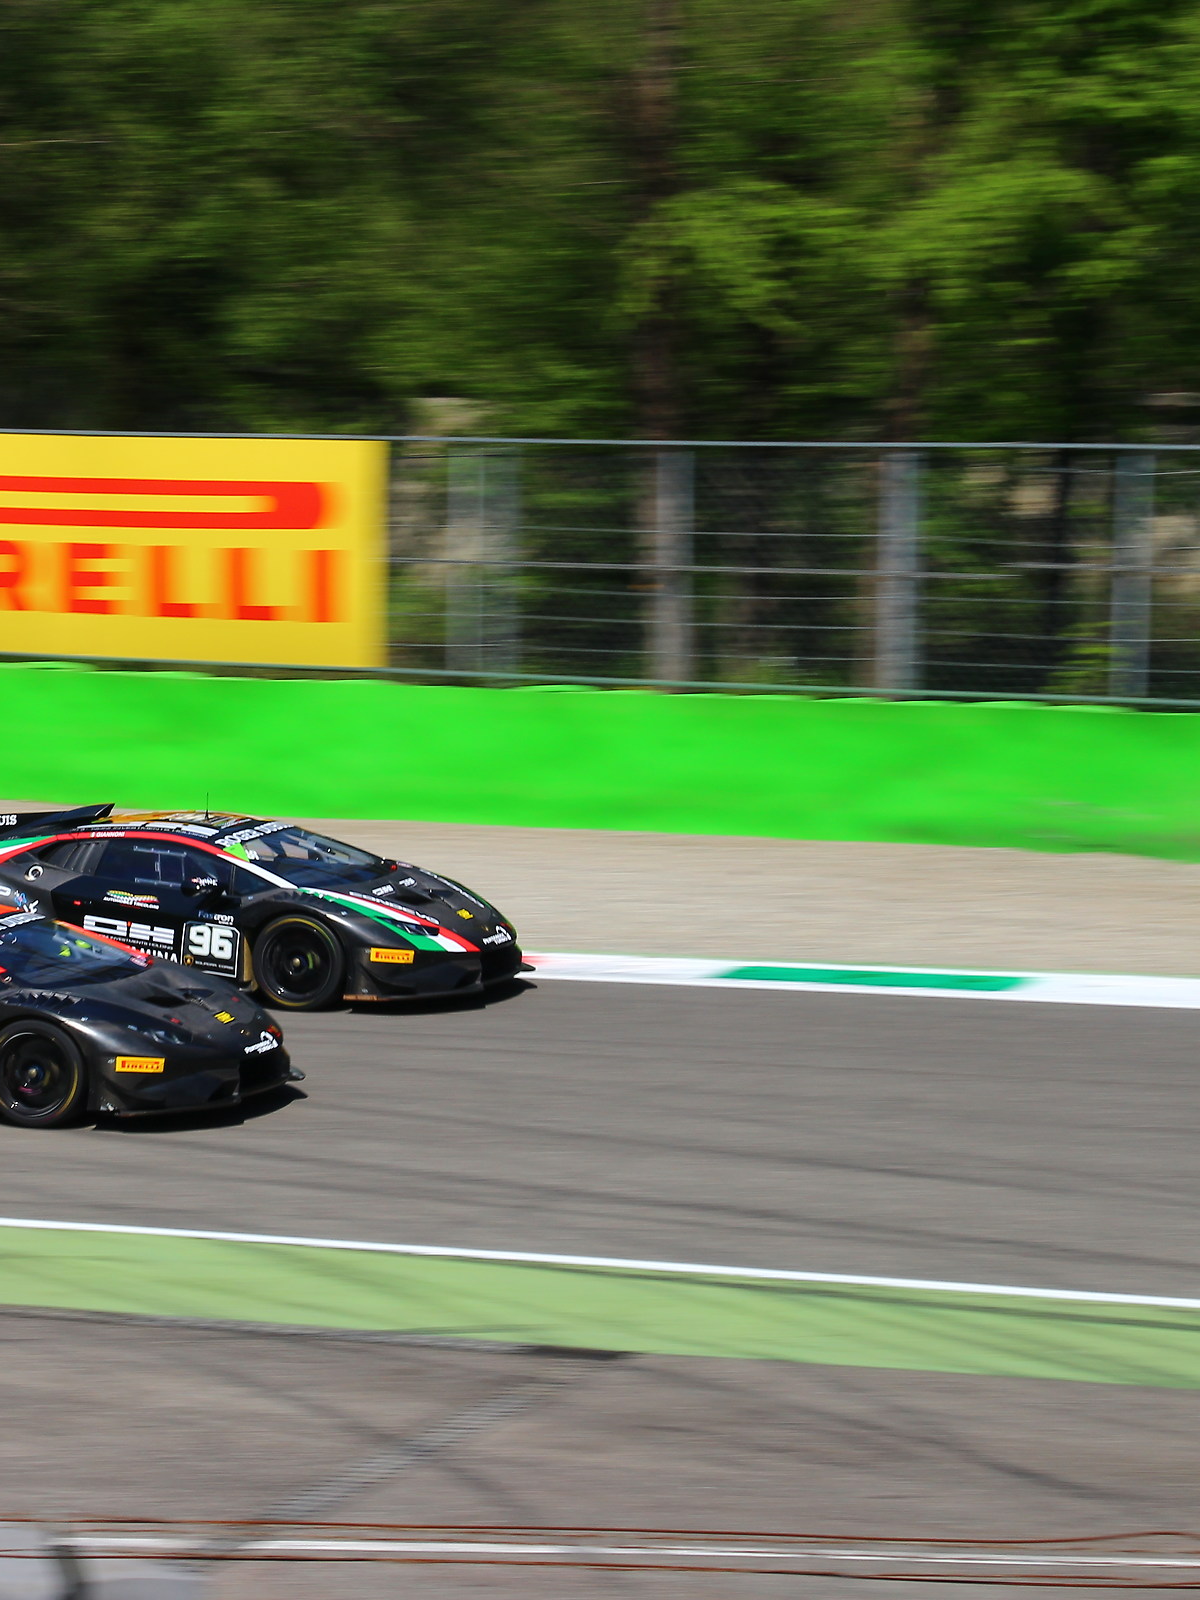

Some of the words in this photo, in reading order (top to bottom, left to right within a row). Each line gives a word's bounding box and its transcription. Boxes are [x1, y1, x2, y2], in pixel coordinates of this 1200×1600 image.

[188, 925, 234, 960] 96
[375, 951, 411, 962] PIRELLI
[121, 1060, 160, 1070] PIRELLI
